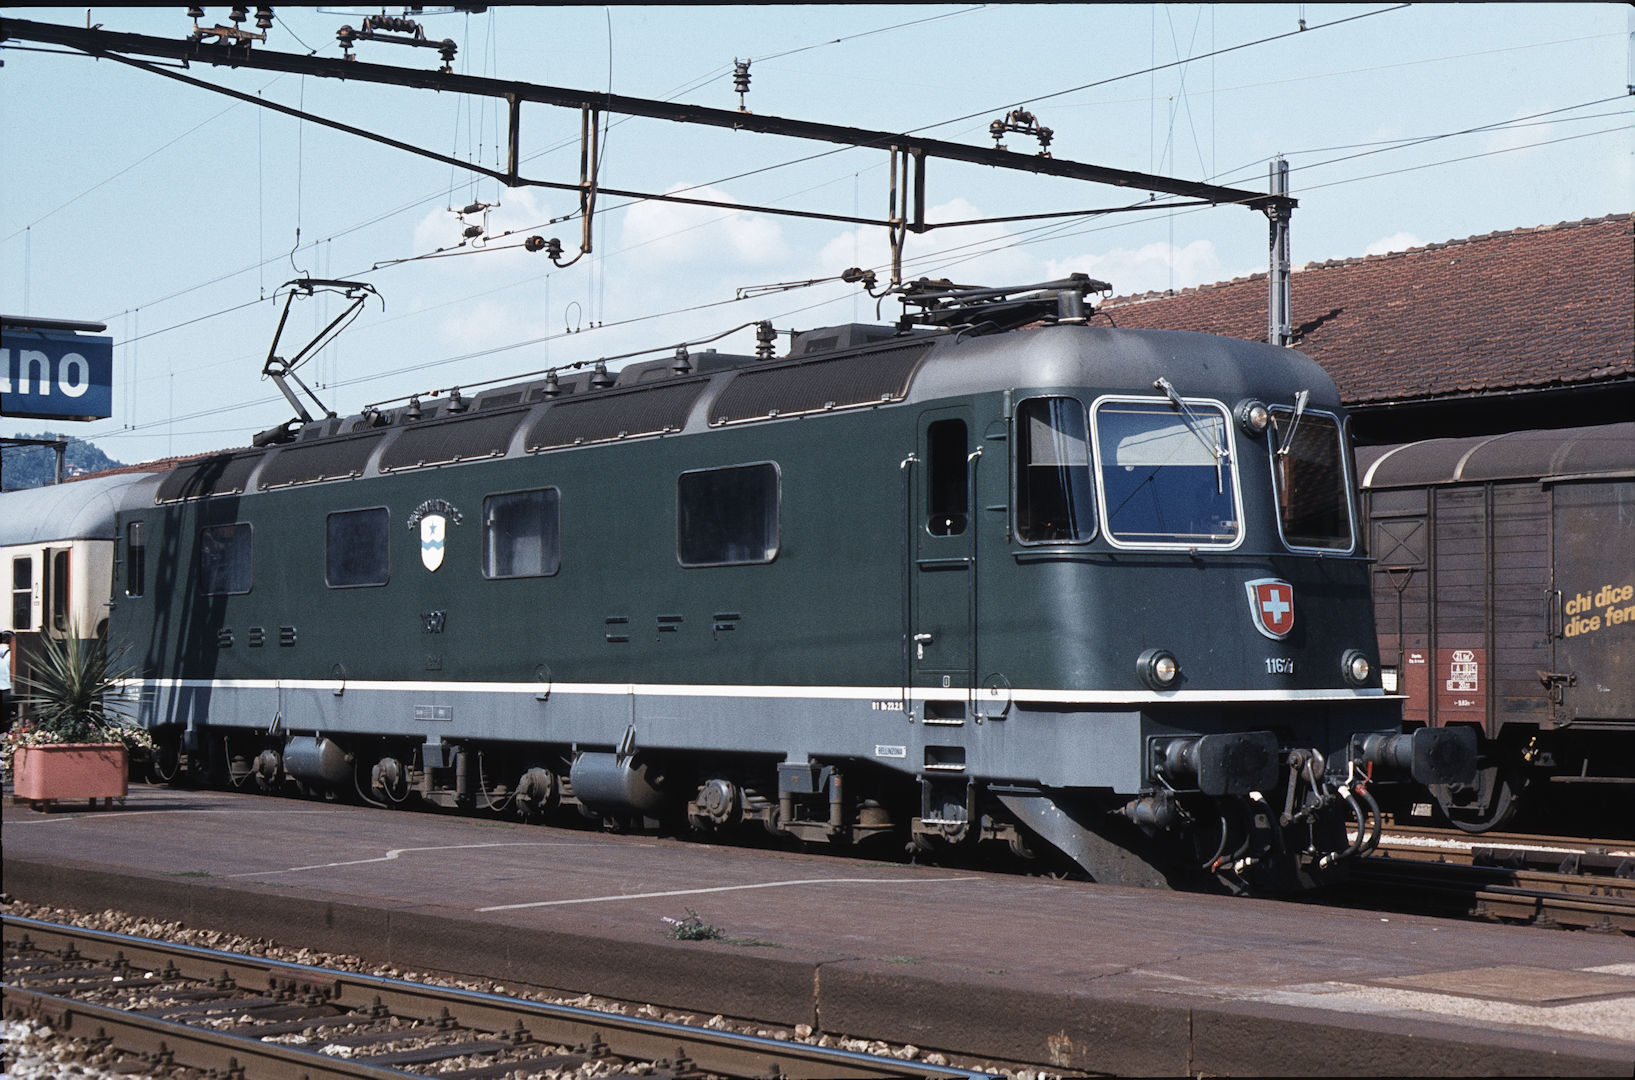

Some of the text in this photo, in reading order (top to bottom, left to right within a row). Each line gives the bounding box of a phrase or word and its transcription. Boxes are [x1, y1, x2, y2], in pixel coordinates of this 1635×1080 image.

[1565, 584, 1634, 615] chi dice
[1565, 615, 1601, 637] dice
